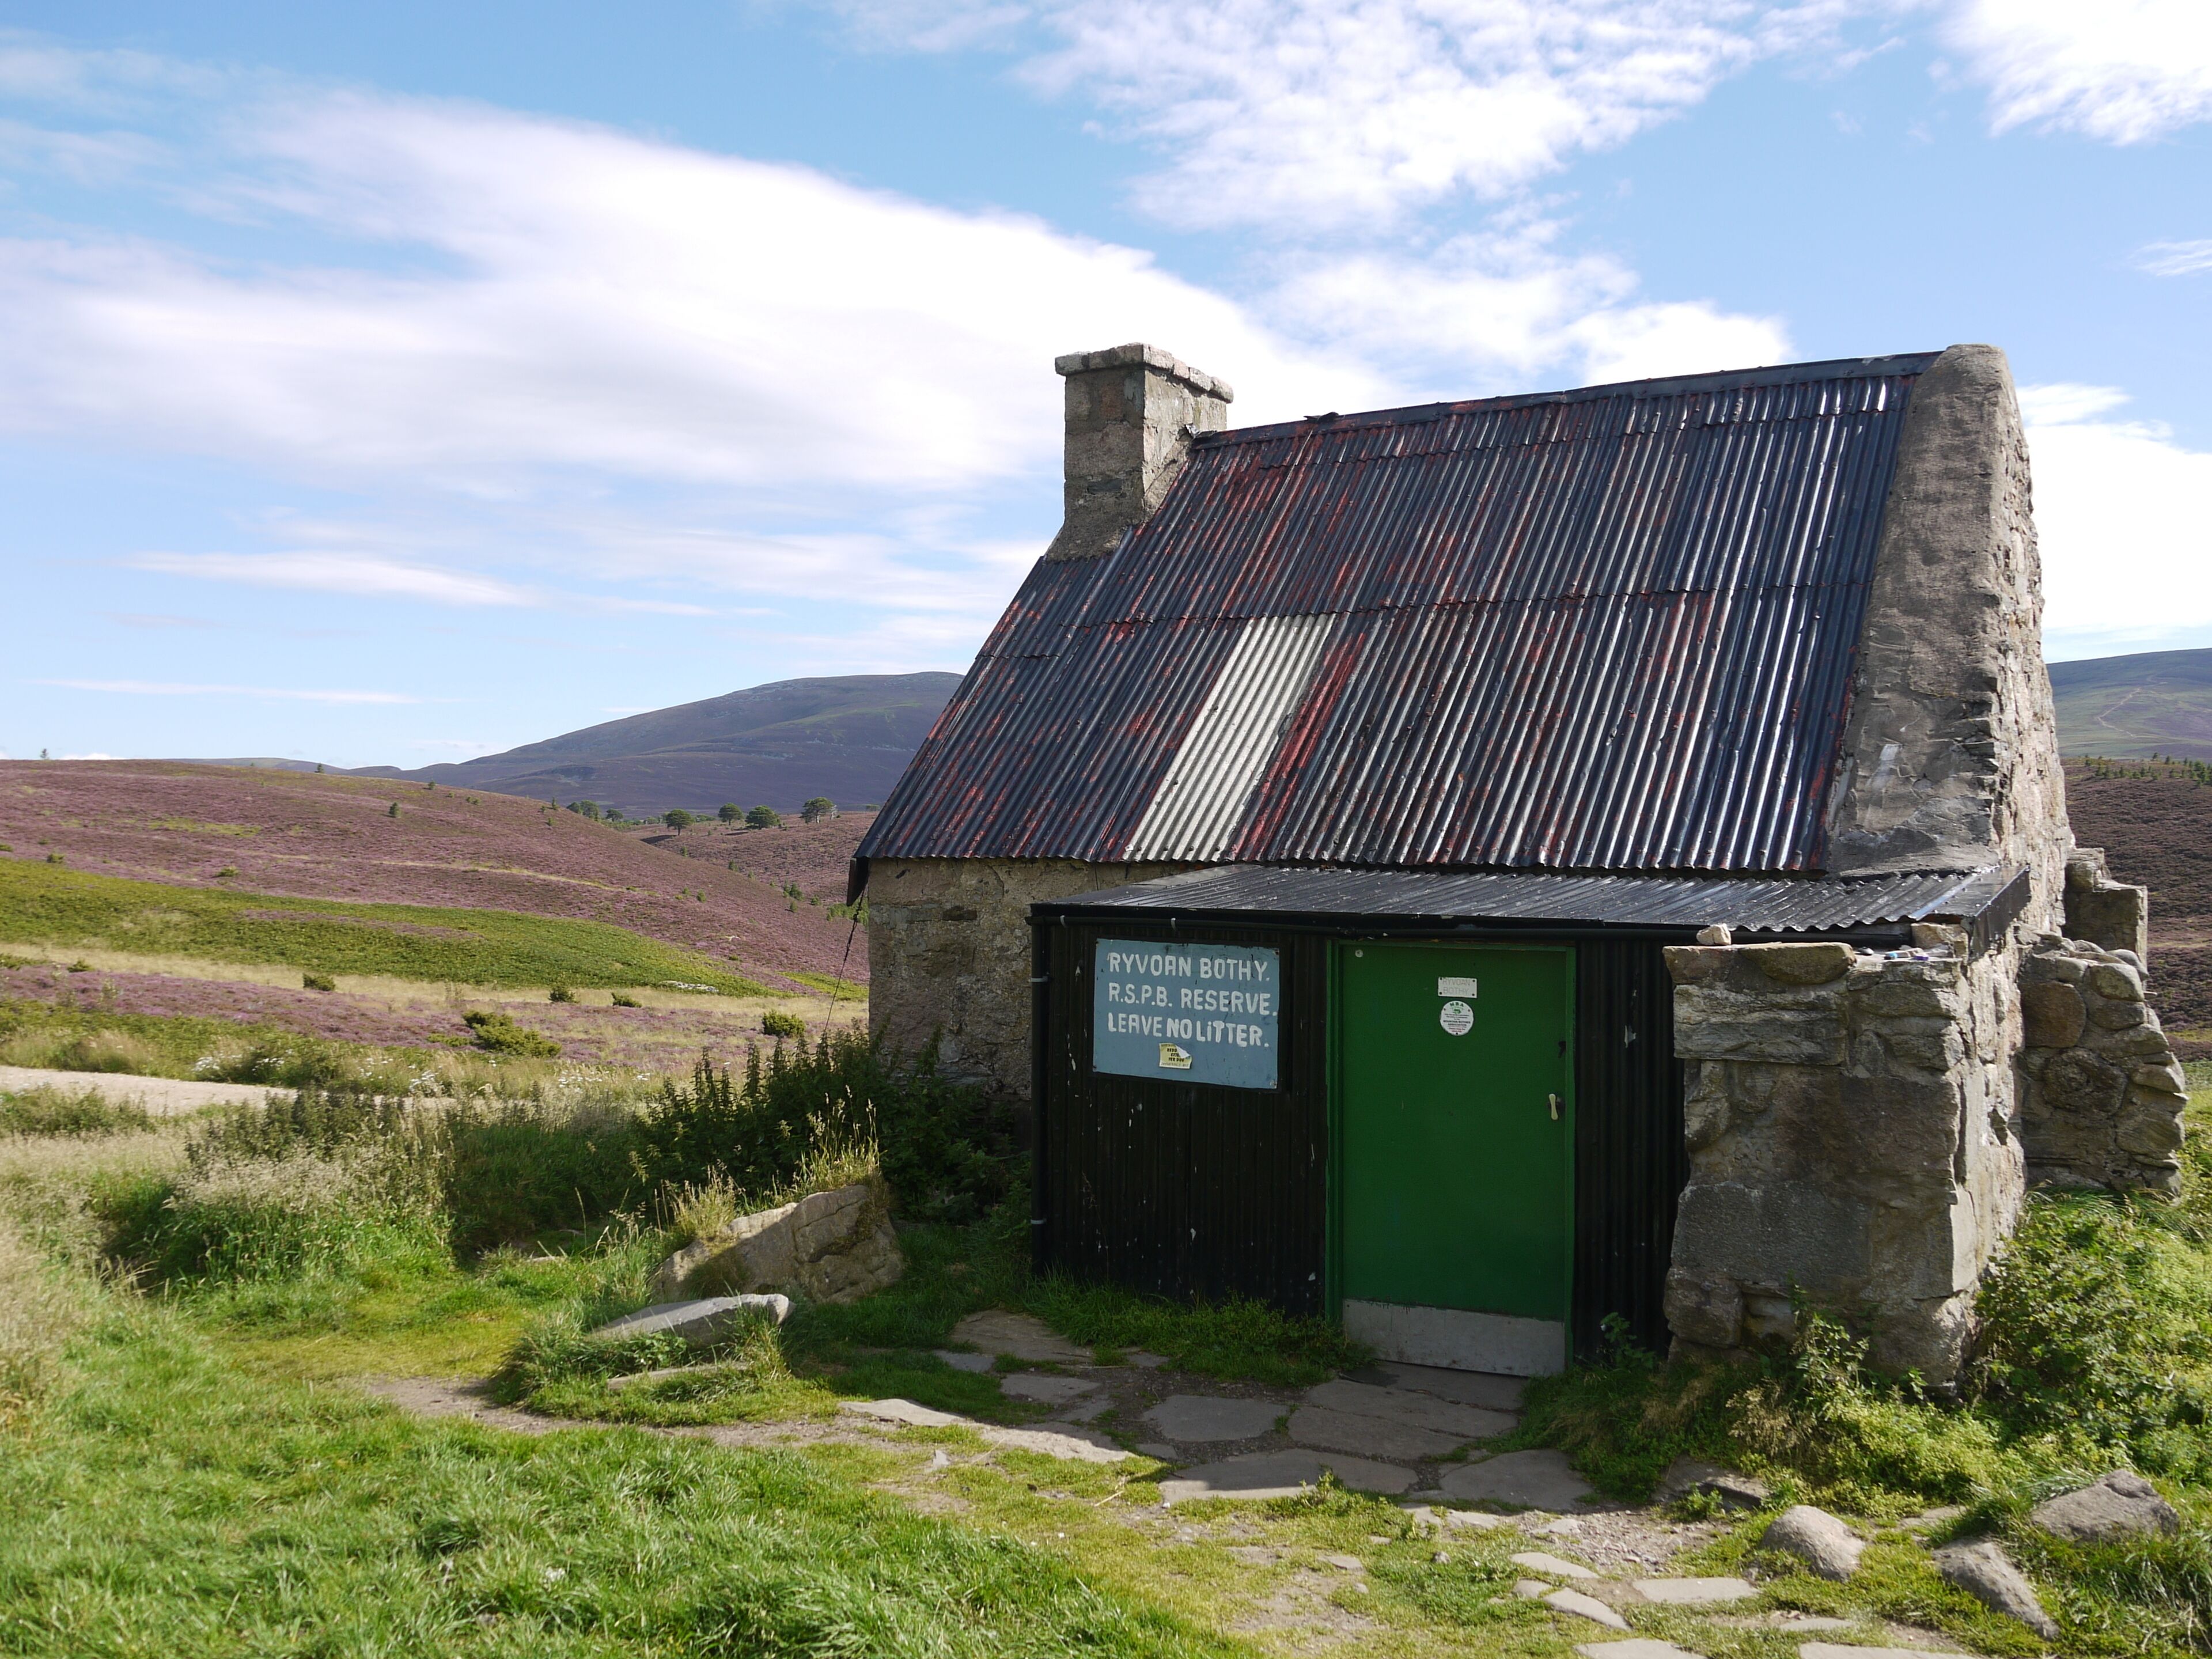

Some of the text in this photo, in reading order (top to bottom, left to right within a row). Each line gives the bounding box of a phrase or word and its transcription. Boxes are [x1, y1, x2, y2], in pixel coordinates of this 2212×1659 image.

[1107, 952, 1270, 981] RYVOAN BOTHY.
[1108, 982, 1278, 1016] R.S.P.B. RESERVE.
[1443, 987, 1469, 995] BOTHY
[1108, 1012, 1162, 1037] LEAVE
[1166, 1018, 1192, 1039] NO
